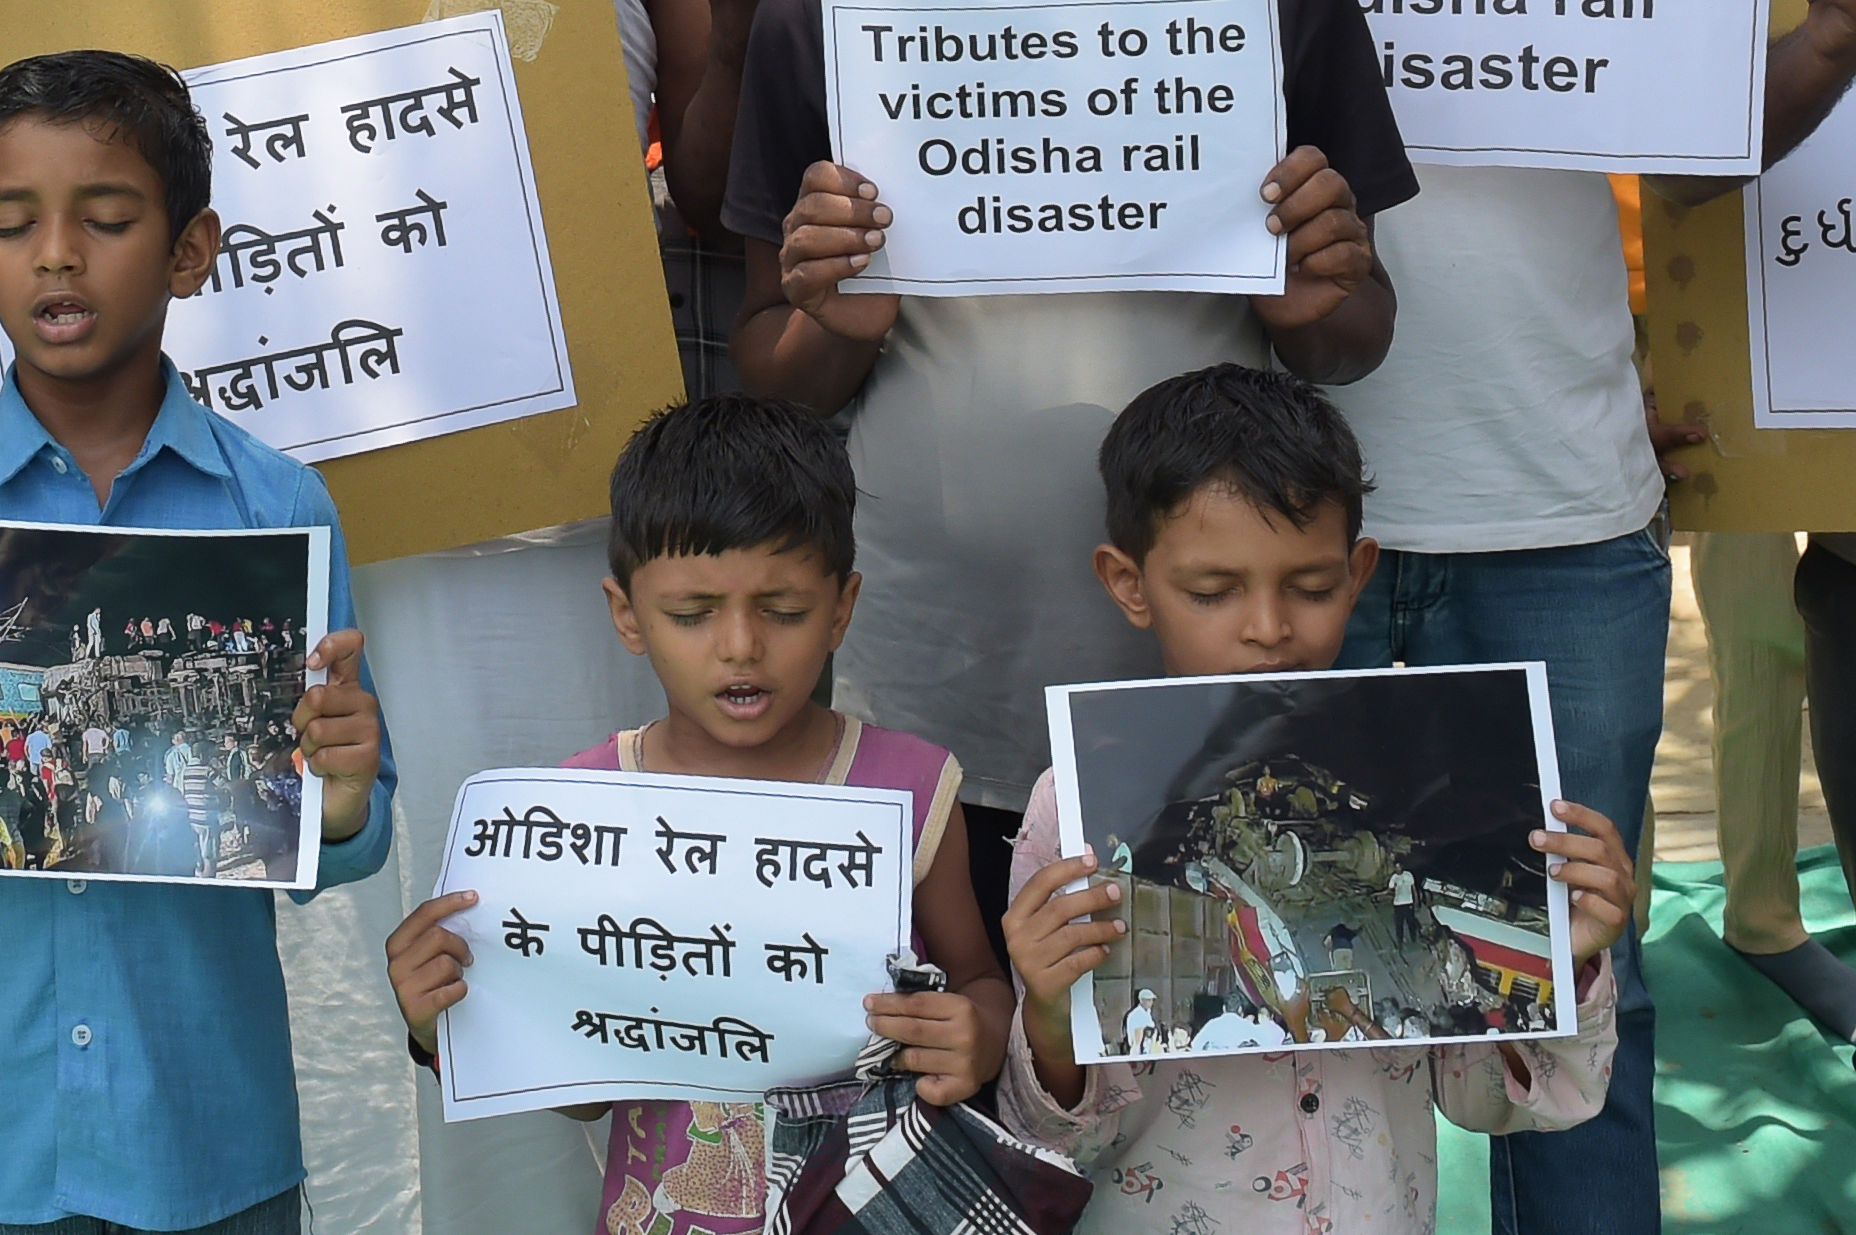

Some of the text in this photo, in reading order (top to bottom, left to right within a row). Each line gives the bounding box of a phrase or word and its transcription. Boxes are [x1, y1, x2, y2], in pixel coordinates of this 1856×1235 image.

[861, 17, 1246, 63] Tributes to the
[1384, 40, 1611, 94] isaster
[222, 66, 481, 170] रेल हादसे
[878, 76, 1235, 120] victims of the
[918, 134, 1200, 176] Odisha rail
[375, 188, 448, 254] को
[957, 194, 1168, 235] disaster
[464, 805, 883, 889] ओडिशा रेल हादसे
[502, 907, 829, 985] के पीड़ितों को
[570, 1006, 775, 1064] श्रद्धांजलि
